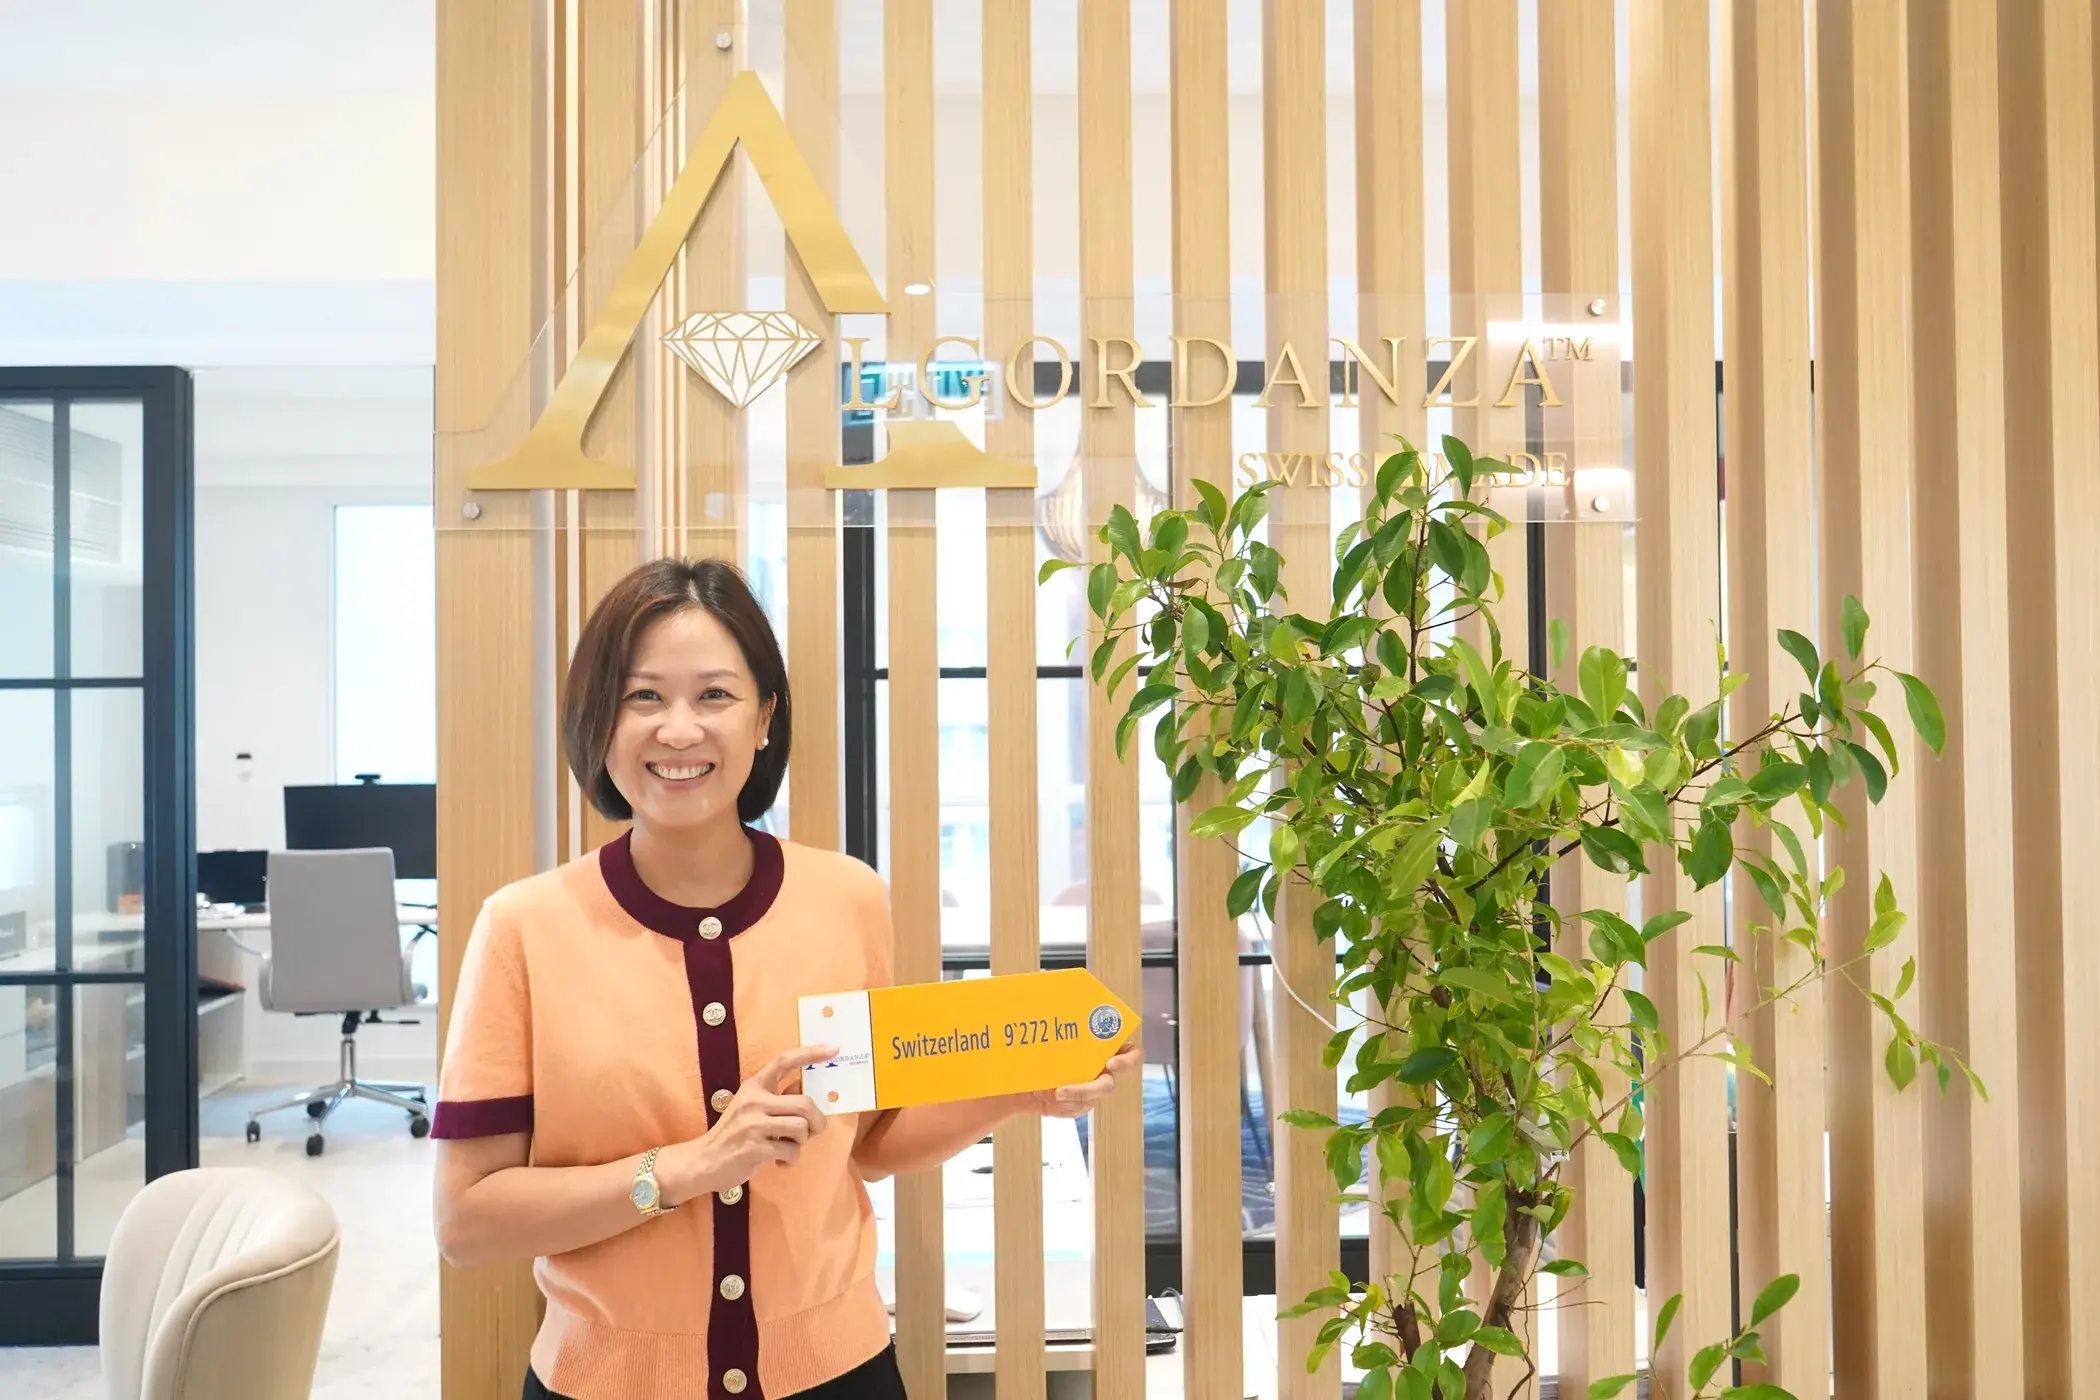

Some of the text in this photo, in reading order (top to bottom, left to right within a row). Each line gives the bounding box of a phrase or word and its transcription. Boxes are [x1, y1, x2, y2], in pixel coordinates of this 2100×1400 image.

[1237, 452, 1369, 488] SWISS
[892, 1024, 990, 1060] Switzerland
[1054, 1016, 1079, 1042] km
